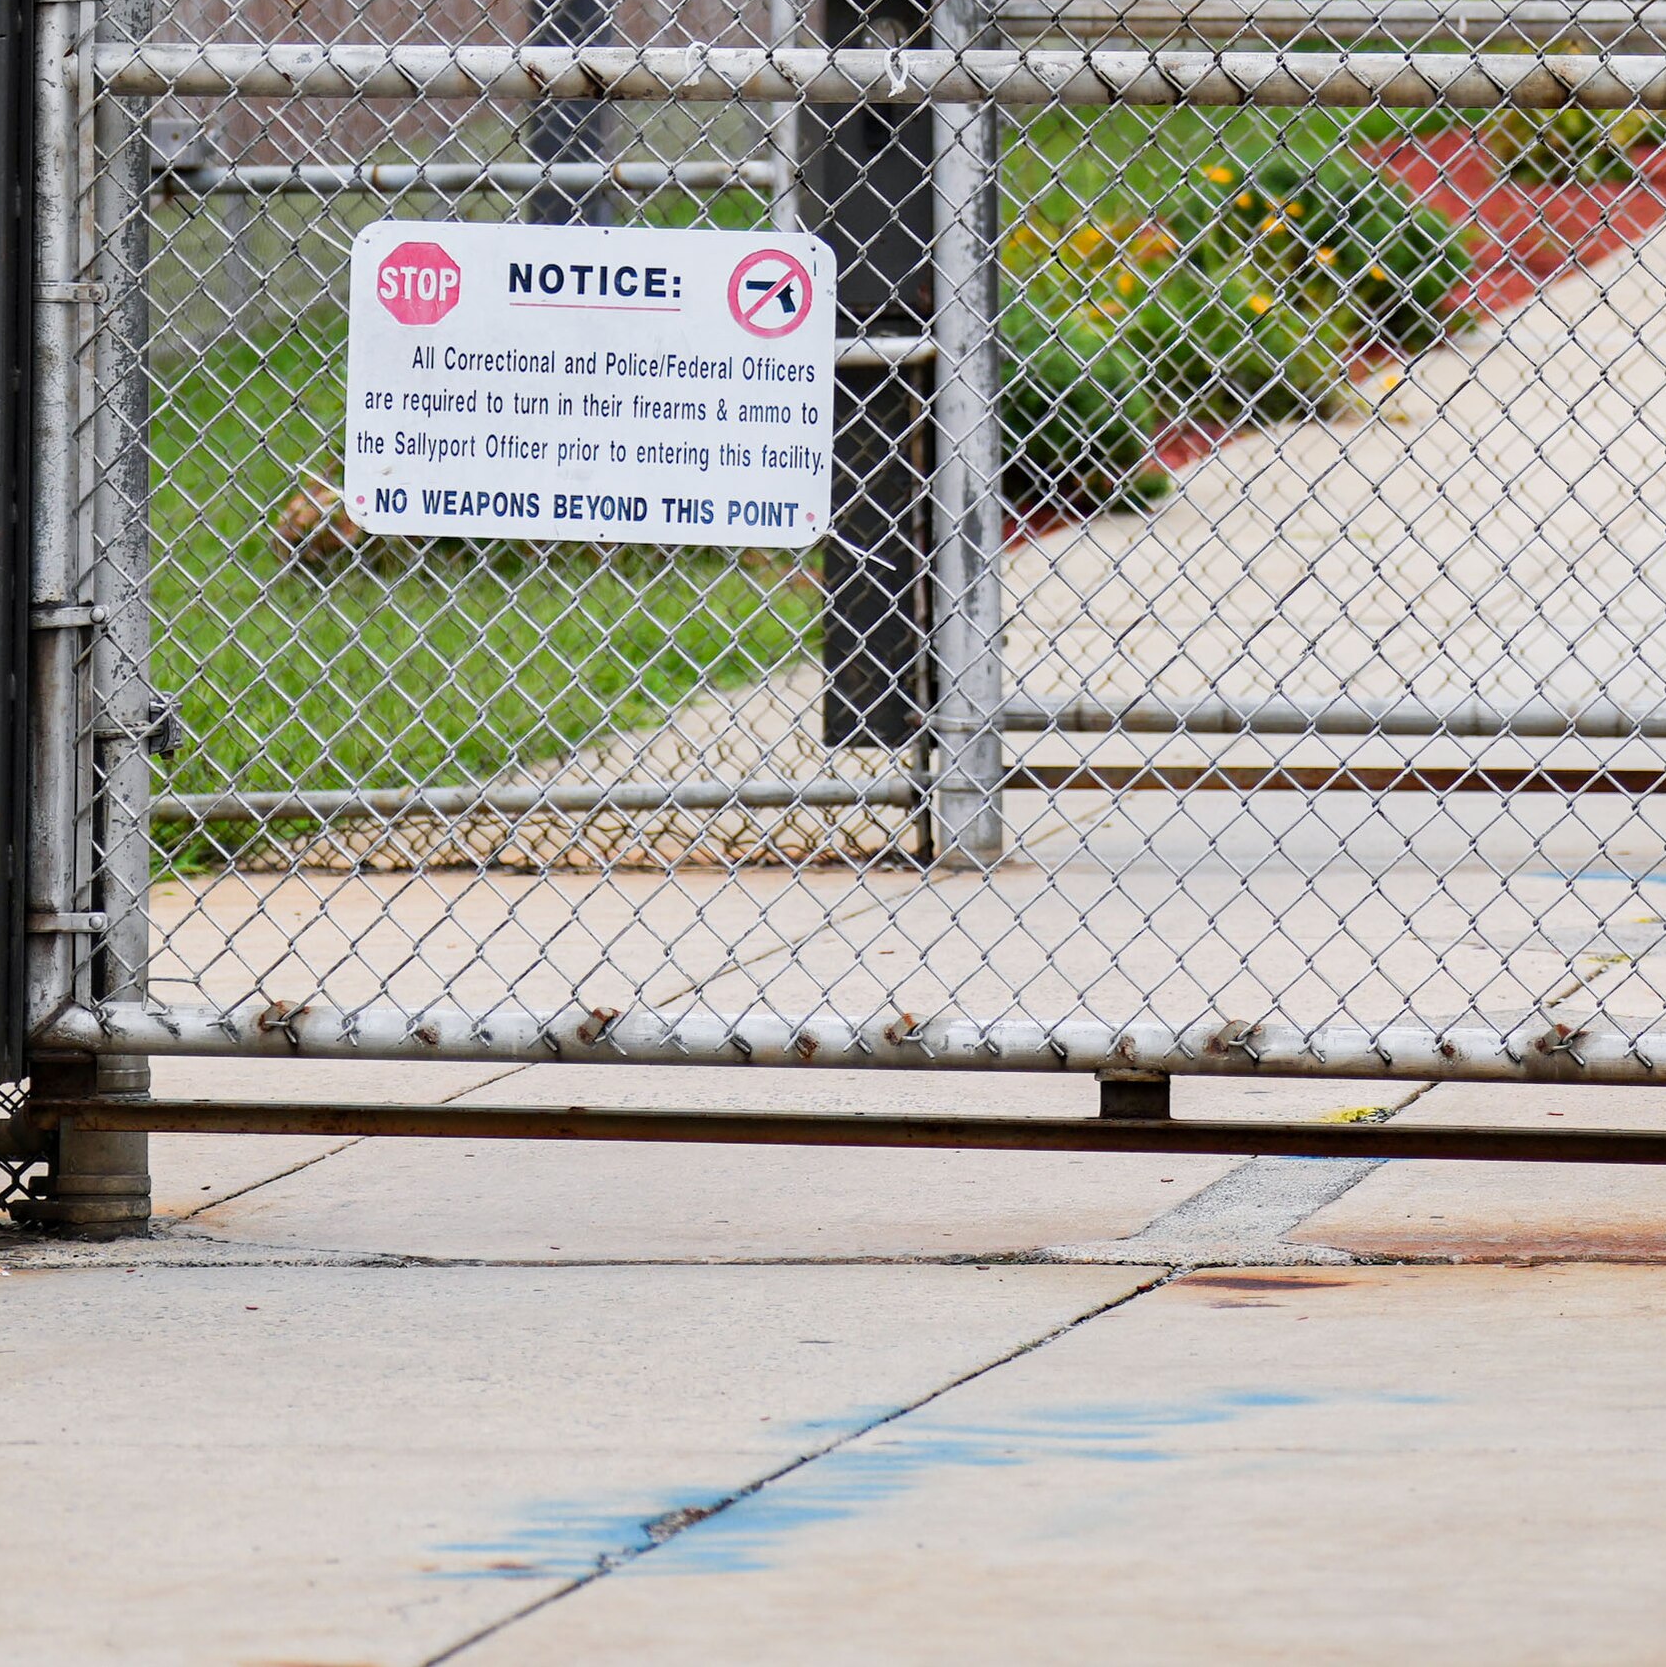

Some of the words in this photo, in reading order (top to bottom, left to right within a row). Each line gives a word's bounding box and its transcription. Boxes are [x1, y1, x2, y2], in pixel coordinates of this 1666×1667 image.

[380, 266, 458, 302] STOP
[509, 263, 681, 298] NOTICE:
[412, 346, 434, 369] All
[445, 346, 555, 373] Correctional
[565, 352, 596, 375] and
[606, 352, 732, 379] Police/Federal
[743, 357, 814, 382] Officers
[365, 392, 393, 410] are
[403, 388, 477, 418] required
[487, 392, 503, 413] to
[514, 393, 548, 414] turn
[558, 392, 572, 415] in
[583, 393, 622, 417] their
[633, 395, 706, 420] firearms
[717, 398, 727, 421] &
[739, 405, 791, 423] ammo
[802, 402, 818, 424] to
[357, 430, 384, 454] the
[395, 431, 475, 463] Sallyport
[486, 434, 548, 459] Officer
[558, 438, 599, 466] prior
[610, 440, 626, 462] to
[637, 441, 709, 472] entering
[720, 443, 750, 467] this
[762, 444, 824, 476] facility.
[376, 488, 407, 514] NO
[422, 489, 539, 518] WEAPONS
[554, 494, 647, 521] BEYOND
[662, 498, 714, 524] THIS
[728, 500, 799, 527] POINT
